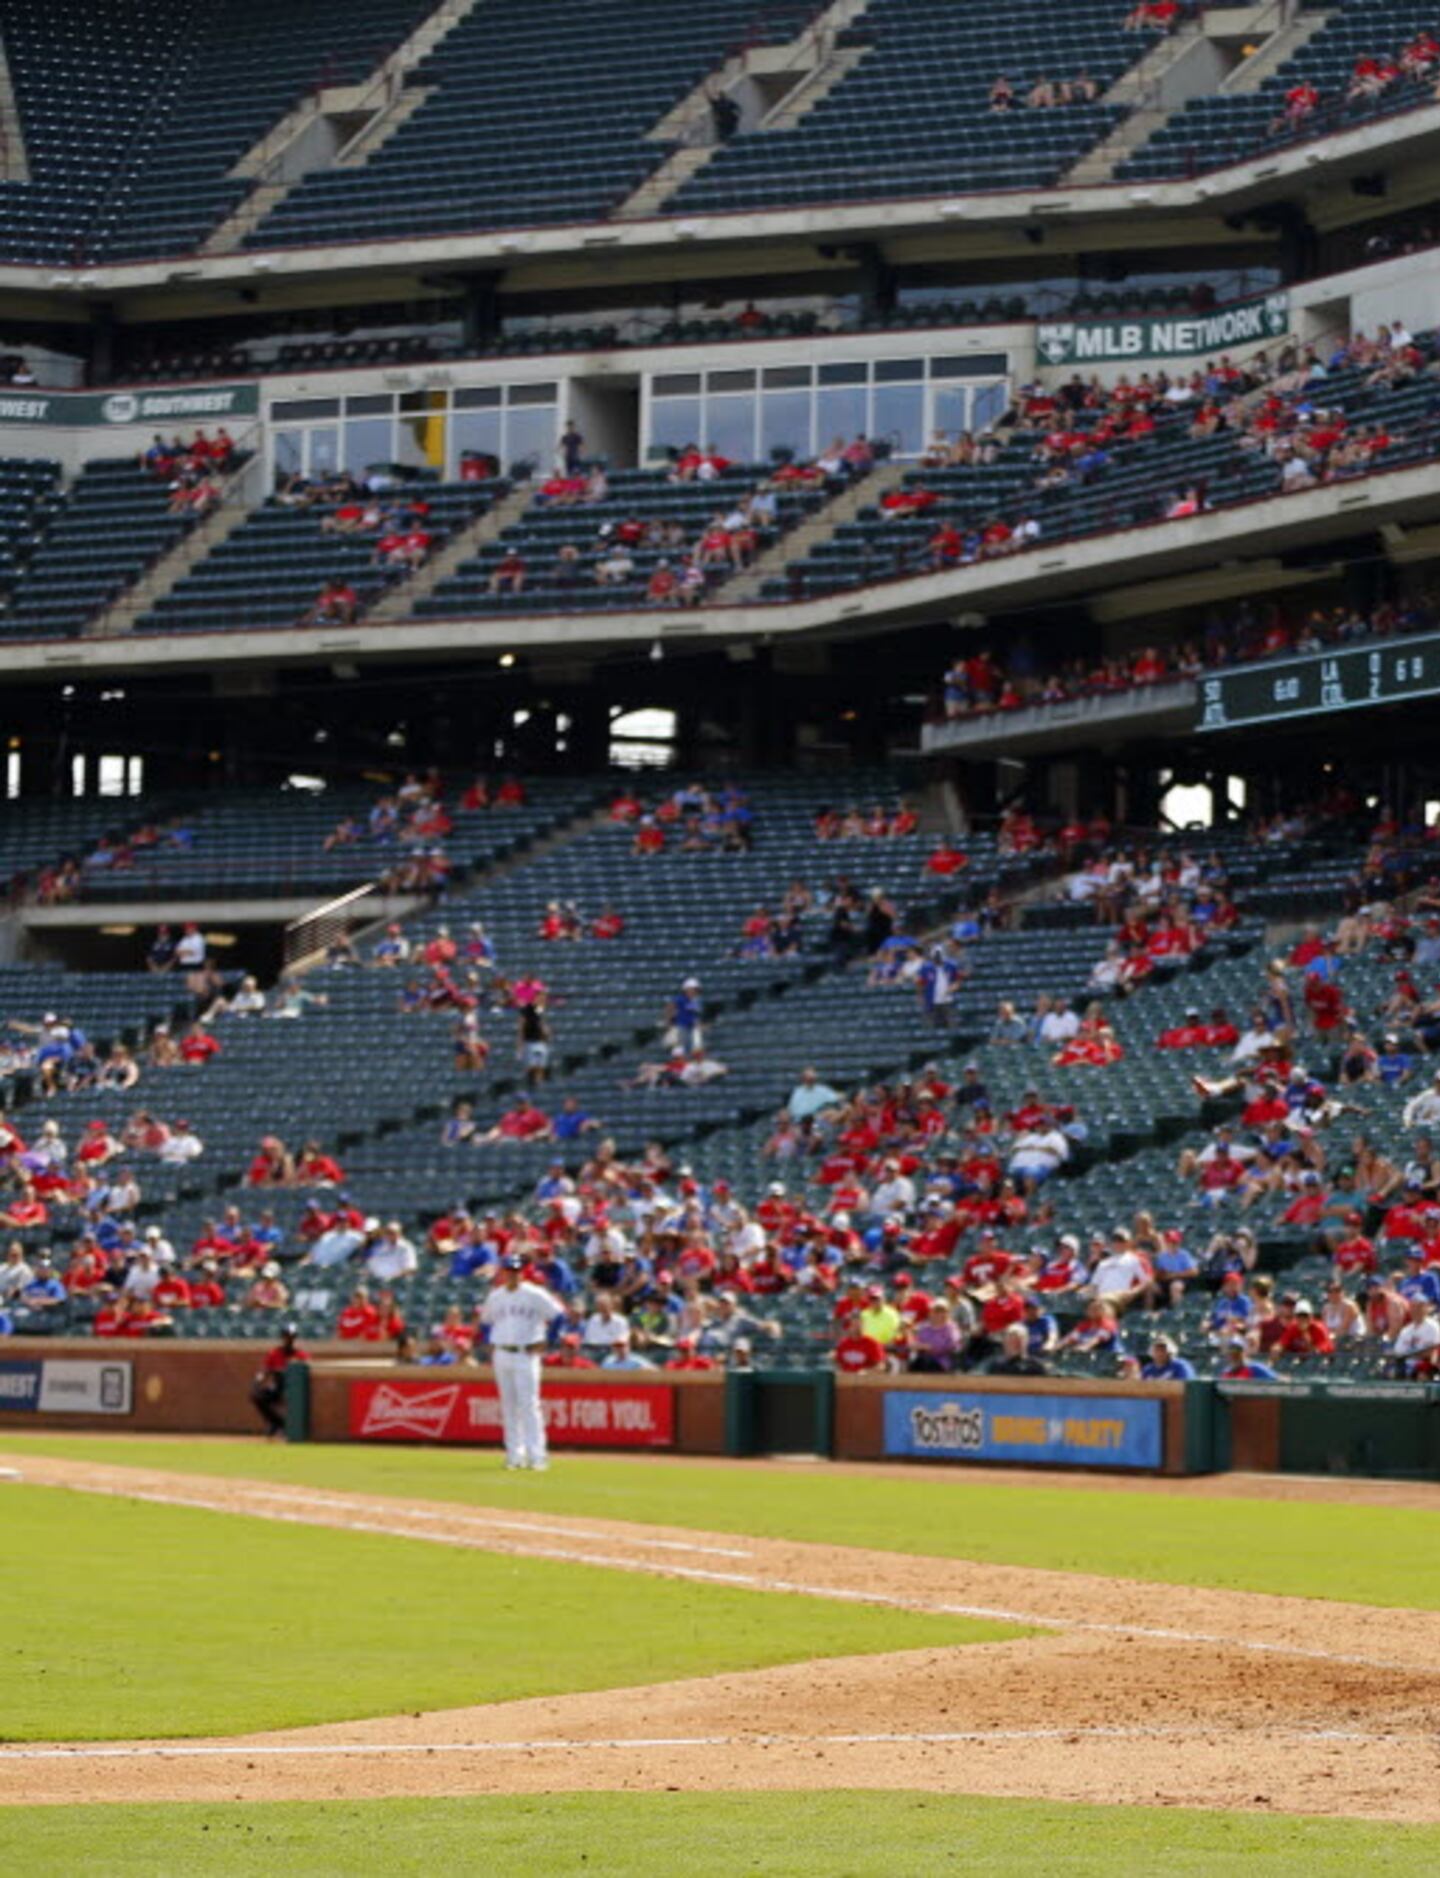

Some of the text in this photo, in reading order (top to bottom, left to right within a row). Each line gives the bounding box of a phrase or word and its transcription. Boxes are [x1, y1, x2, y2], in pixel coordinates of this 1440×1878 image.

[1076, 305, 1264, 357] MLB NETWORK
[142, 393, 235, 416] SOUTHWEST
[571, 1400, 607, 1429] FOR
[1064, 1417, 1125, 1447] PARTY
